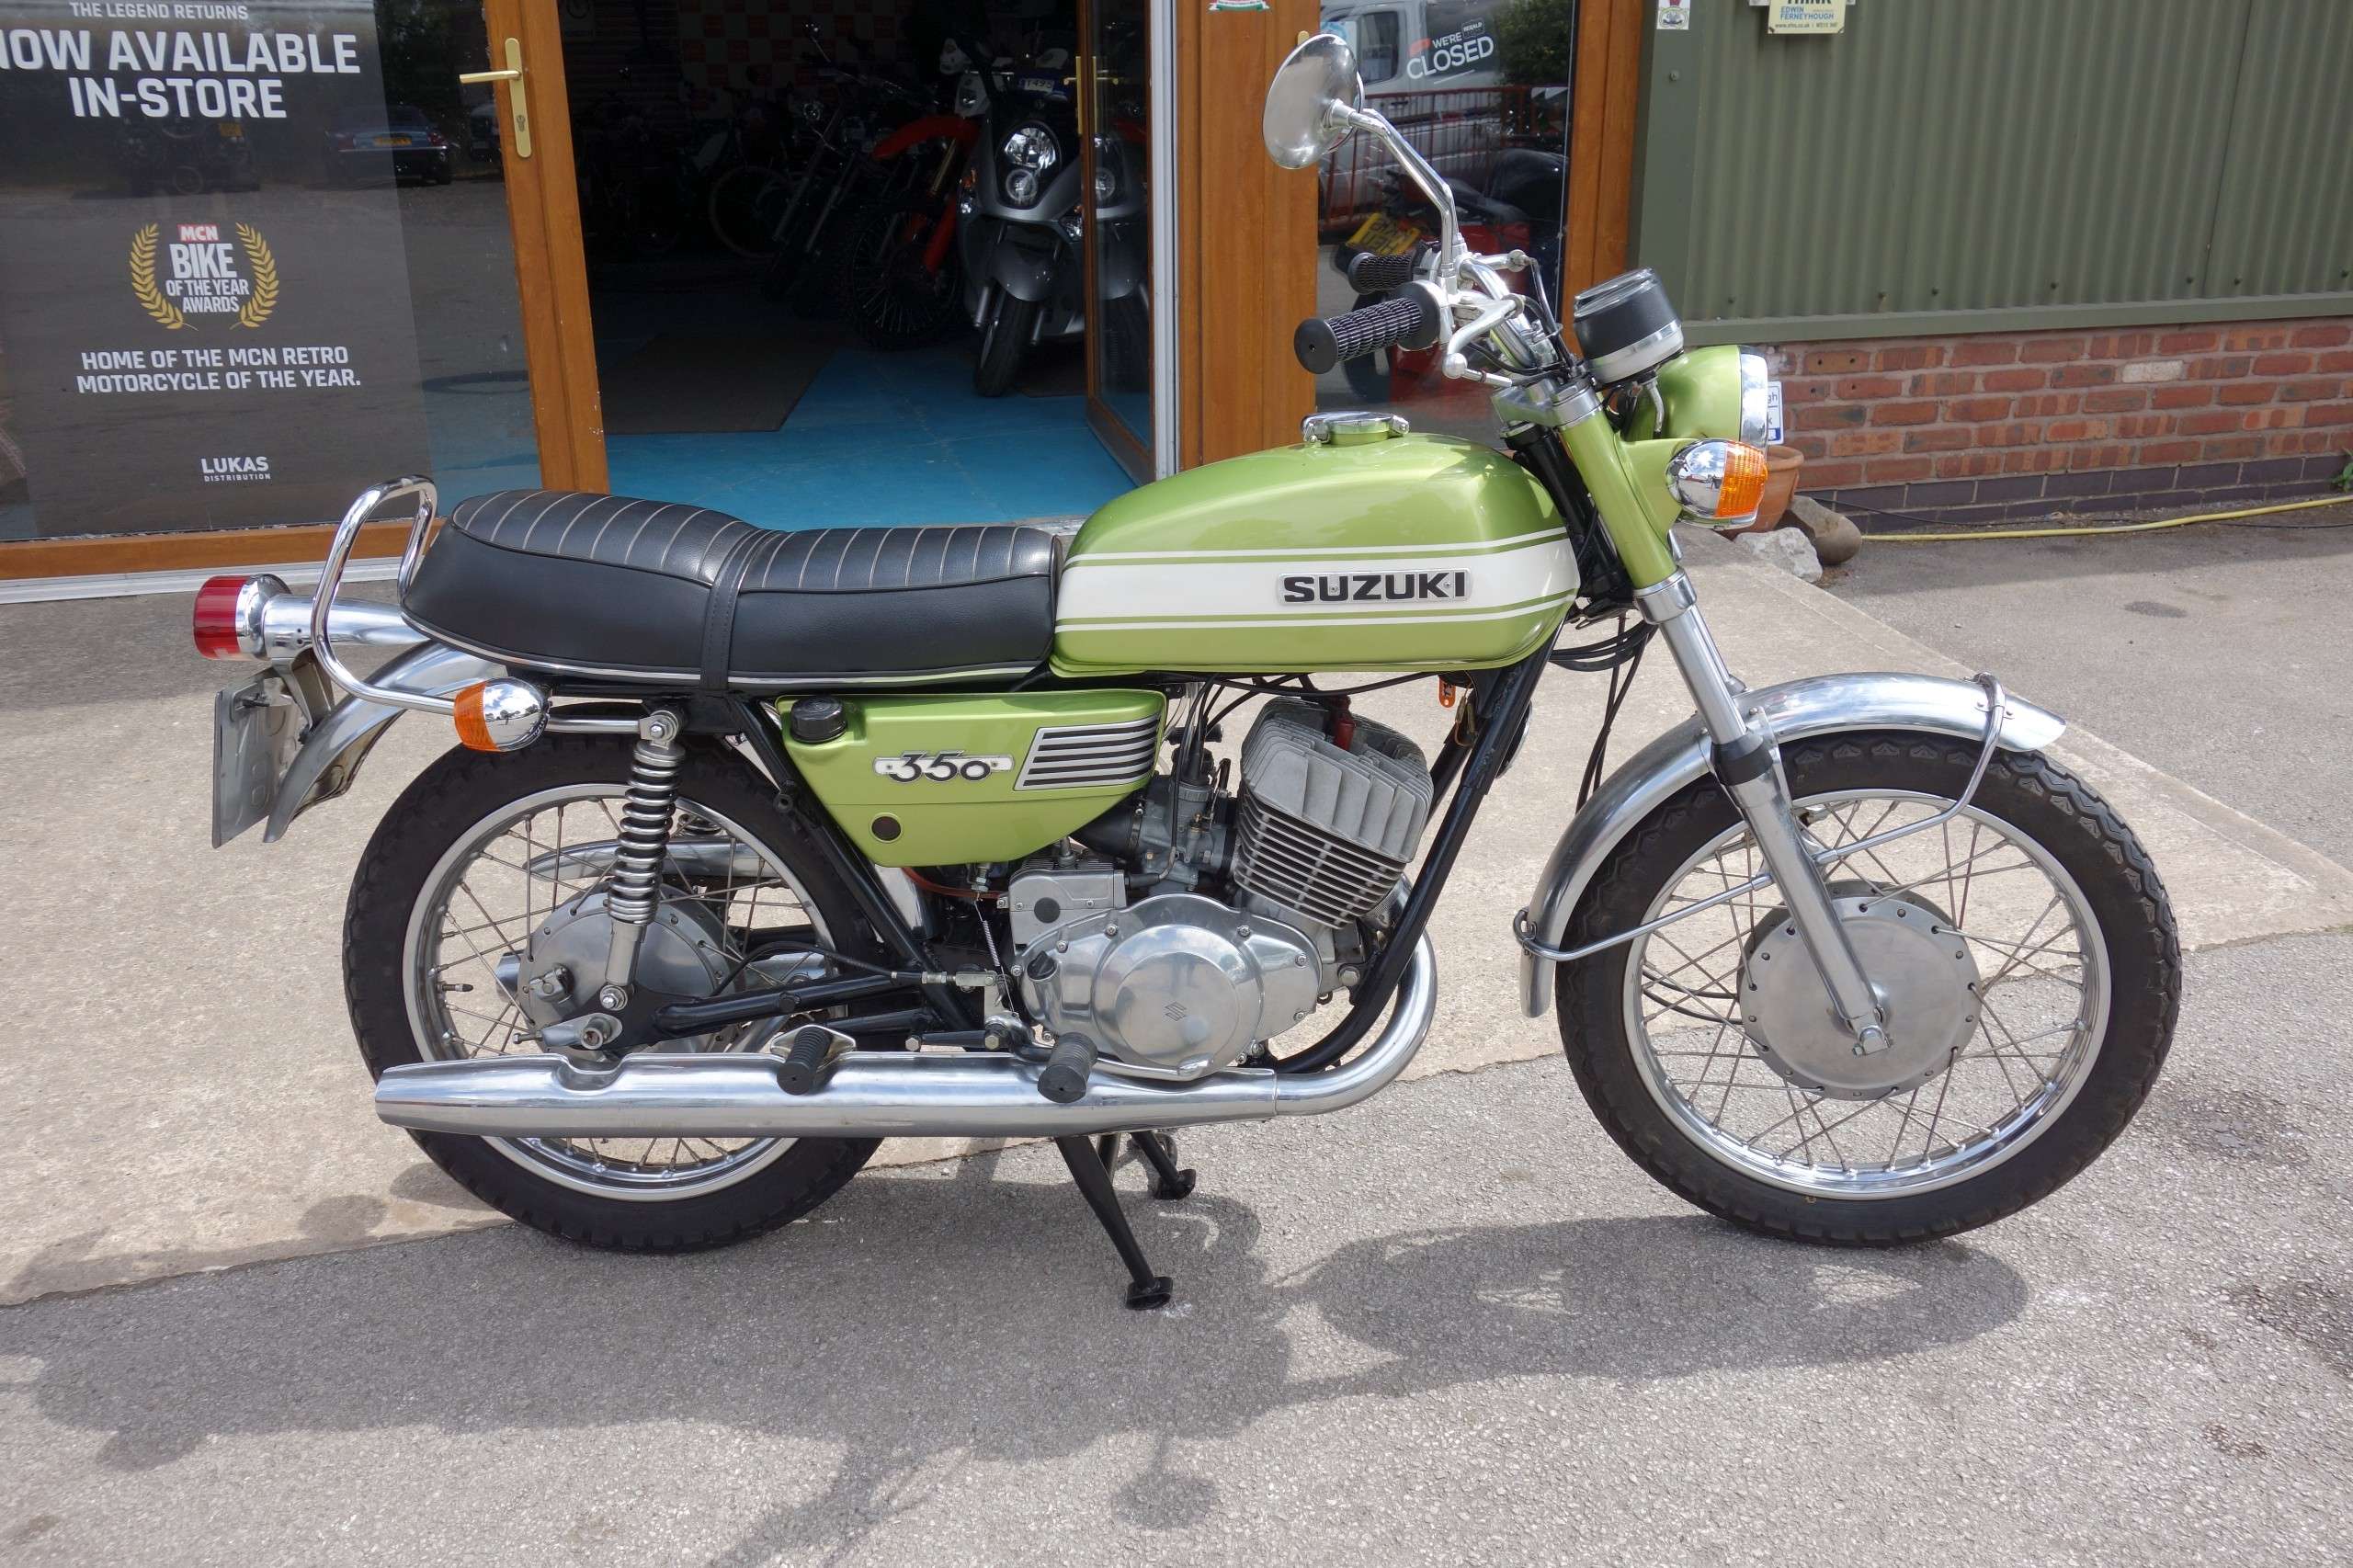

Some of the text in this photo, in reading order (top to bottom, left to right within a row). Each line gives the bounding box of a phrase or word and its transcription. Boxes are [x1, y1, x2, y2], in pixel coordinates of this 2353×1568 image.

[69, 2, 249, 19] THE LEGEND RETURNS
[108, 30, 361, 73] AVAILABLE
[1432, 32, 1462, 49] WE'RE
[1406, 36, 1494, 79] CLOSED
[69, 77, 288, 118] IN-STORE
[180, 226, 219, 241] MCN
[169, 244, 237, 278] BIKE
[165, 279, 250, 297] OF THE YEAR
[183, 297, 240, 313] AWARDS
[81, 346, 349, 370] HOME OF THE MCN RETRO
[76, 368, 361, 393] MOTORCYCLE OF THE YEAR.
[200, 456, 269, 474] LUKAS
[204, 473, 271, 482] DISTRIBUTION
[1283, 571, 1465, 603] SUZUKI
[888, 750, 993, 782] 350
